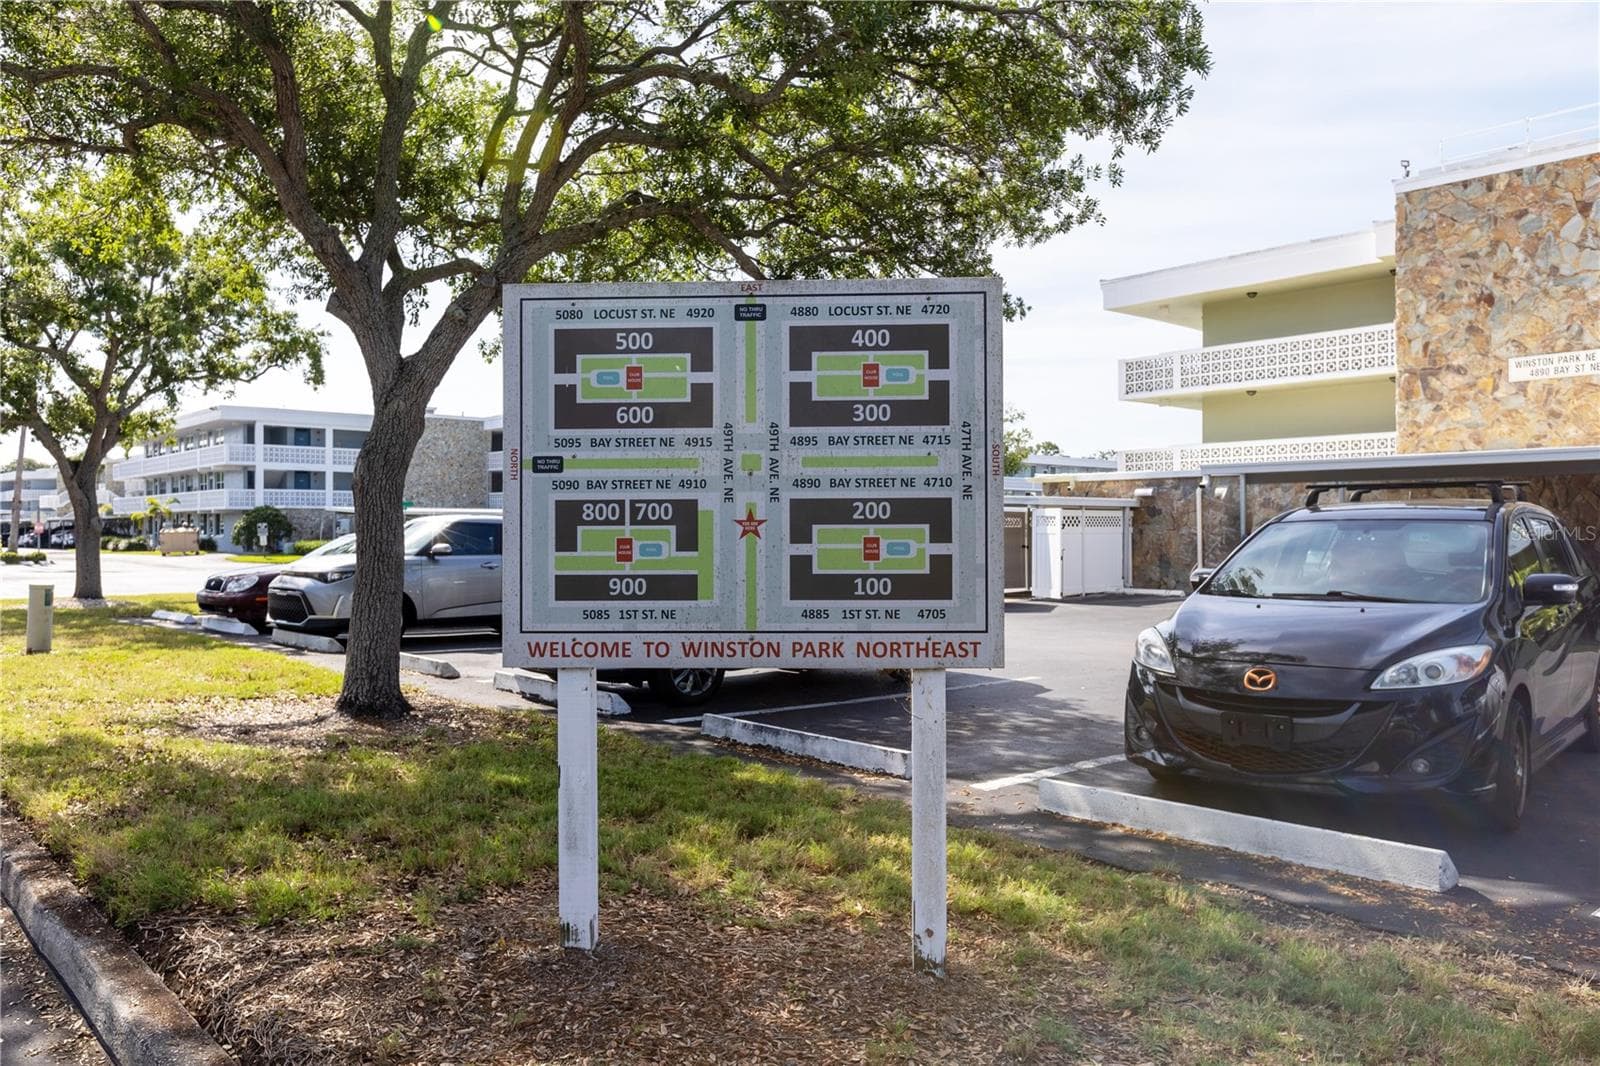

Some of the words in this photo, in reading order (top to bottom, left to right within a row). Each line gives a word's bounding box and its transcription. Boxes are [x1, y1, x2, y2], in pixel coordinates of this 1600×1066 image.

[556, 310, 583, 320] 5080
[594, 309, 637, 319] LOCUST
[641, 309, 656, 319] ST.
[660, 309, 675, 318] NE
[687, 308, 714, 318] 4920
[791, 307, 818, 316] 4880
[829, 306, 873, 316] LOCUST
[877, 306, 892, 315] ST.
[896, 305, 911, 315] NE
[922, 304, 949, 314] 4720
[616, 332, 652, 349] 500
[852, 329, 889, 346] 400
[1515, 358, 1554, 368] WINSTON
[1554, 366, 1569, 374] BAY
[1575, 364, 1584, 372] ST
[617, 407, 653, 423] 600
[853, 404, 890, 421] 300
[554, 438, 581, 448] 5095
[591, 438, 611, 447] BAY
[615, 438, 656, 447] STREET
[660, 437, 674, 447] NE
[685, 437, 712, 447] 4915
[724, 422, 733, 452] 49TH
[769, 422, 779, 451] 49TH
[790, 436, 817, 446] 4895
[828, 436, 849, 445] BAY
[853, 436, 895, 445] STREET
[899, 435, 914, 445] NE
[923, 435, 951, 445] 4715
[961, 421, 971, 450] 47TH
[723, 458, 733, 484] AVE.
[769, 458, 779, 483] AVE.
[962, 454, 972, 480] AVE.
[552, 480, 579, 490] 5090
[587, 480, 608, 489] BAY
[612, 480, 652, 489] STREET
[656, 480, 671, 489] NE
[679, 479, 706, 489] 4910
[793, 479, 820, 488] 4890
[830, 478, 851, 488] BAY
[855, 478, 896, 488] STREET
[901, 478, 915, 487] NE
[924, 477, 952, 487] 4710
[724, 488, 734, 503] NE
[770, 488, 779, 503] NE
[962, 485, 972, 500] NE
[583, 503, 619, 520] 800
[636, 503, 672, 520] 700
[853, 502, 890, 519] 200
[609, 578, 646, 595] 900
[855, 578, 891, 595] 100
[583, 610, 609, 619] 5085
[619, 610, 638, 619] 1ST
[642, 610, 657, 619] ST.
[661, 610, 676, 619] NE
[801, 609, 829, 619] 4885
[842, 610, 862, 619] 1ST
[865, 609, 880, 619] ST.
[885, 610, 900, 619] NE
[918, 609, 945, 619] 4705
[528, 642, 631, 658] WELCOME
[643, 642, 669, 658] TO
[682, 642, 780, 657] WINSTON
[792, 642, 844, 658] PARK
[857, 642, 981, 658] NORTHEAST
